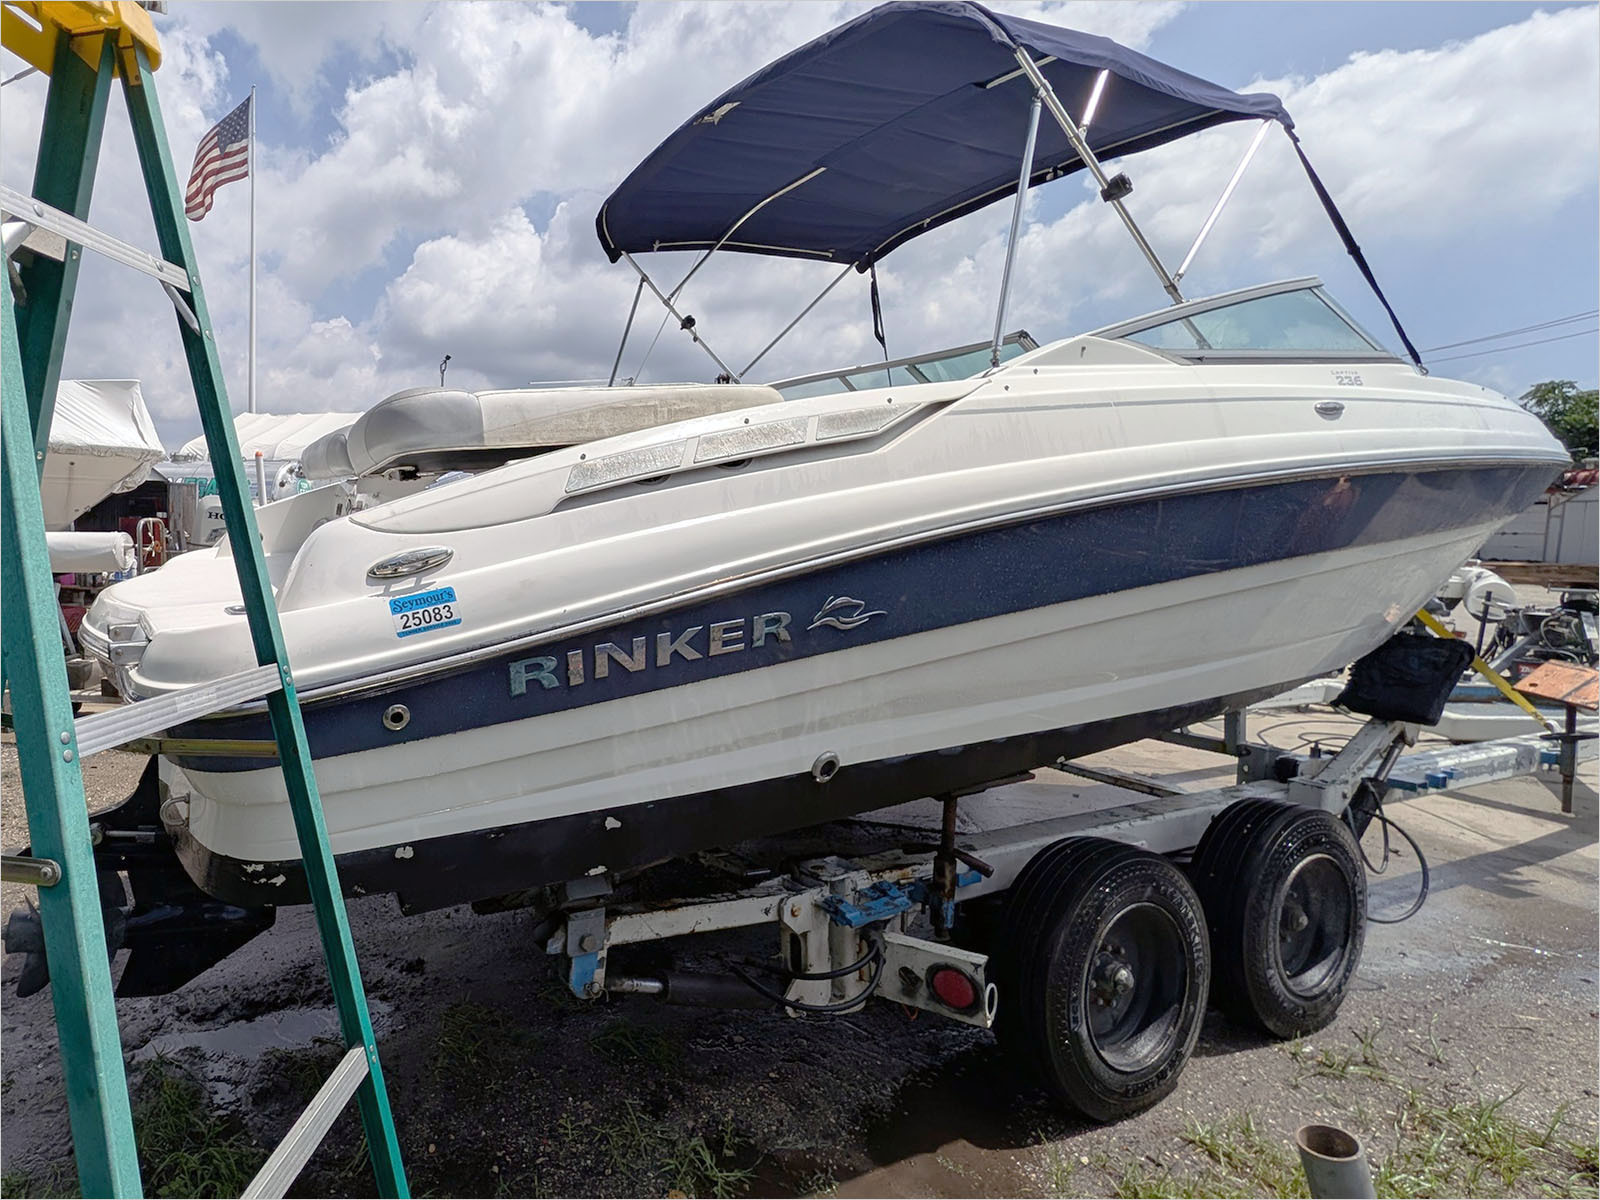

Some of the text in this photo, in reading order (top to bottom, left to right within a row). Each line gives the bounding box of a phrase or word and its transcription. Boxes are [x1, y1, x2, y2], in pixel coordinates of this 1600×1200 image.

[1335, 375, 1364, 387] 236
[392, 590, 454, 613] Seymour's
[400, 604, 454, 630] 25083
[508, 611, 792, 698] RINKER
